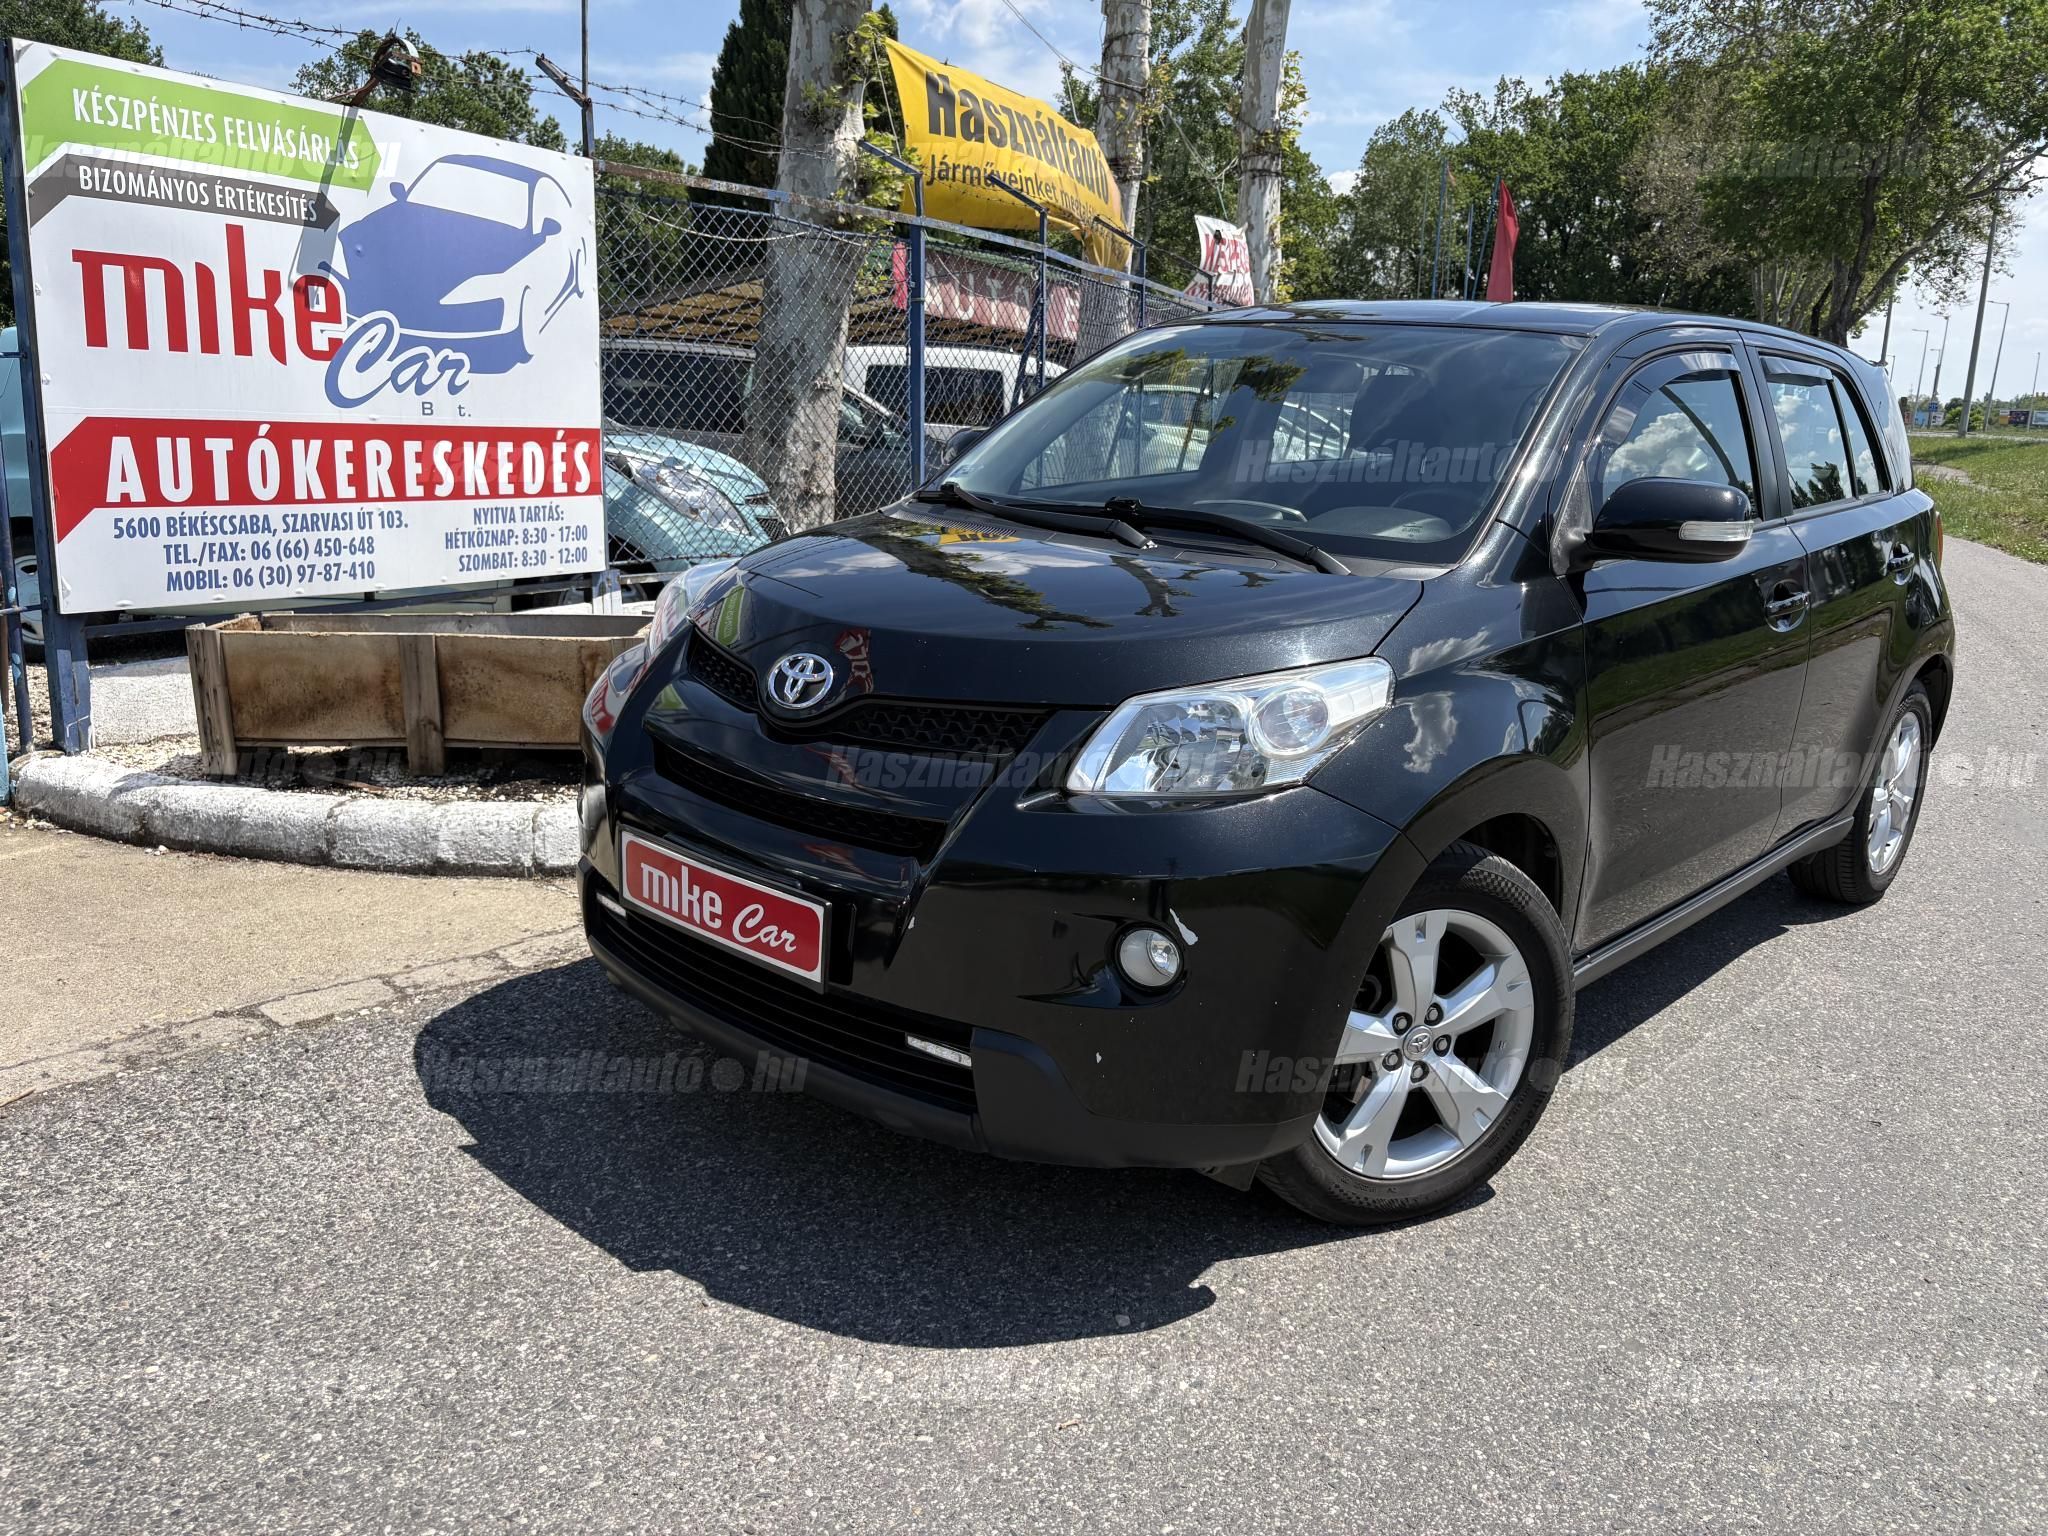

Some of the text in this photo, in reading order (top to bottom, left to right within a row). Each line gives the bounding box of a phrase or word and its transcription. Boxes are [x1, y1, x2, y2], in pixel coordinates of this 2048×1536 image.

[73, 86, 360, 170] KÉSZPÉNZES FELVÁSÁRLÁS
[925, 71, 1109, 205] Használtautó
[79, 165, 317, 222] BIZOMÁNYOS ÉRTÉKESÍTÉS
[72, 224, 470, 408] mike Car
[105, 424, 592, 503] AUTÓKERESKEDÉS
[113, 507, 408, 539] 5600 BÉKÉSCSABA, SZARVASI ÚT 103.
[473, 502, 564, 525] NYITVA TARTÁS:
[164, 536, 375, 566] TEL./FAX: 06 (66) 450-648
[445, 527, 519, 549] HÉTKÖZNAP:
[522, 528, 547, 545] 8:30
[558, 525, 588, 543] 17:00
[167, 561, 375, 592] MOBIL: 06 (30) 97-87-410
[459, 551, 518, 572] SZOMBAT:
[522, 550, 547, 567] 8:30
[558, 547, 588, 564] 12:00
[640, 862, 797, 953] mike Car
